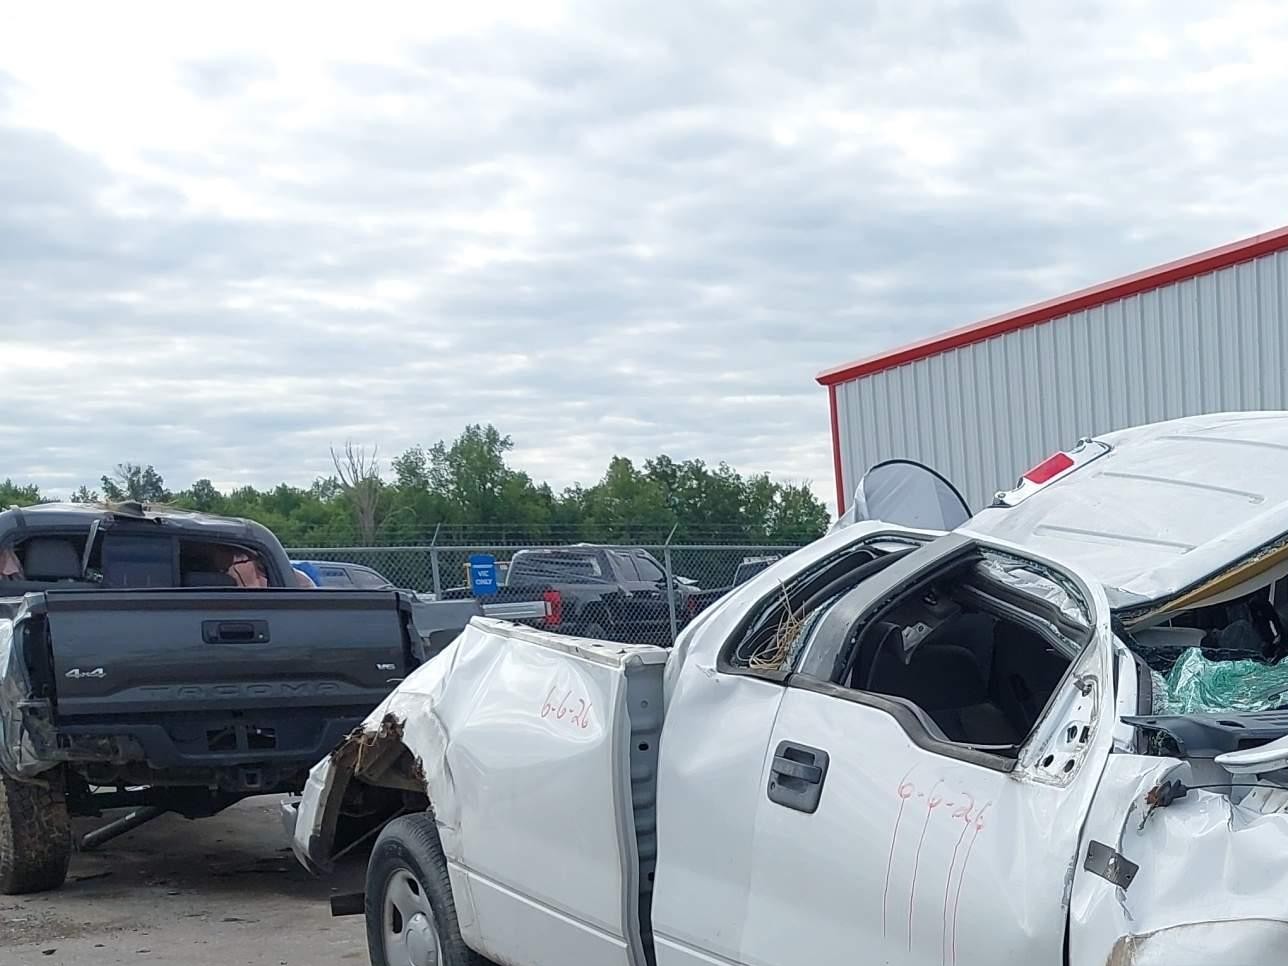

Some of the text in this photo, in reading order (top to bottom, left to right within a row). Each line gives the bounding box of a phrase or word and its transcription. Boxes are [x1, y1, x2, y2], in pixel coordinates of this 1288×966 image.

[376, 663, 396, 671] V6
[140, 682, 340, 697] TACOMA
[541, 686, 593, 729] 6-6-26
